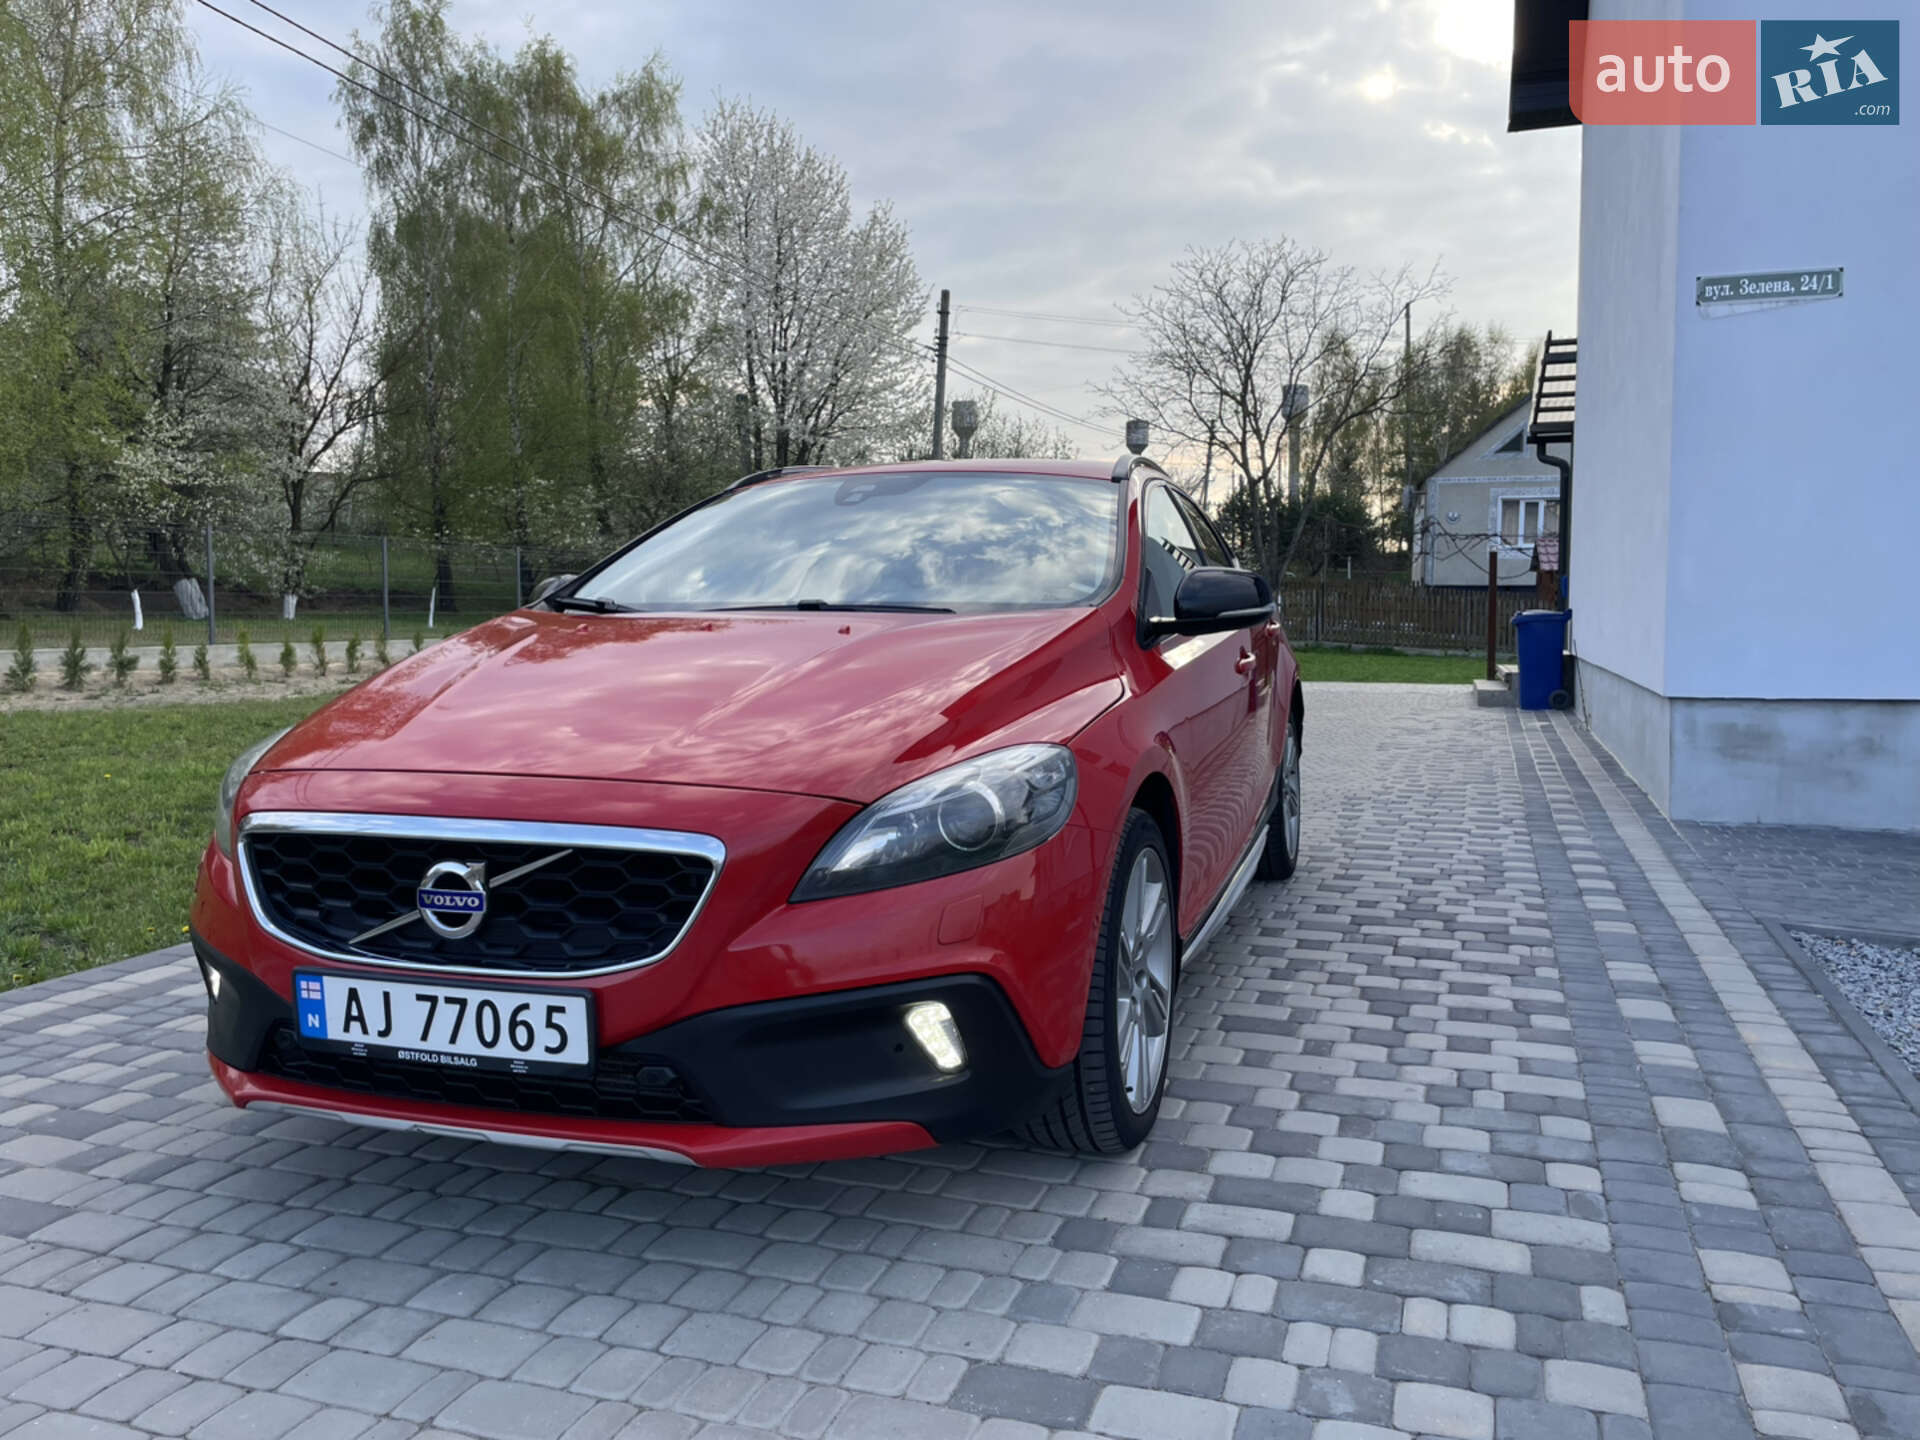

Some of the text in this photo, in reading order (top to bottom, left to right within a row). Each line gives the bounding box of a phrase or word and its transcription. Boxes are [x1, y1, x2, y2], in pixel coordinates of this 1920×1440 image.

[1705, 273, 1833, 300] вул. Зелена, 24/1
[421, 894, 480, 907] VOLVO
[307, 1013, 320, 1028] N
[342, 987, 569, 1055] AJ 77065
[398, 1050, 478, 1067] ØSTFOLD BILSALG
